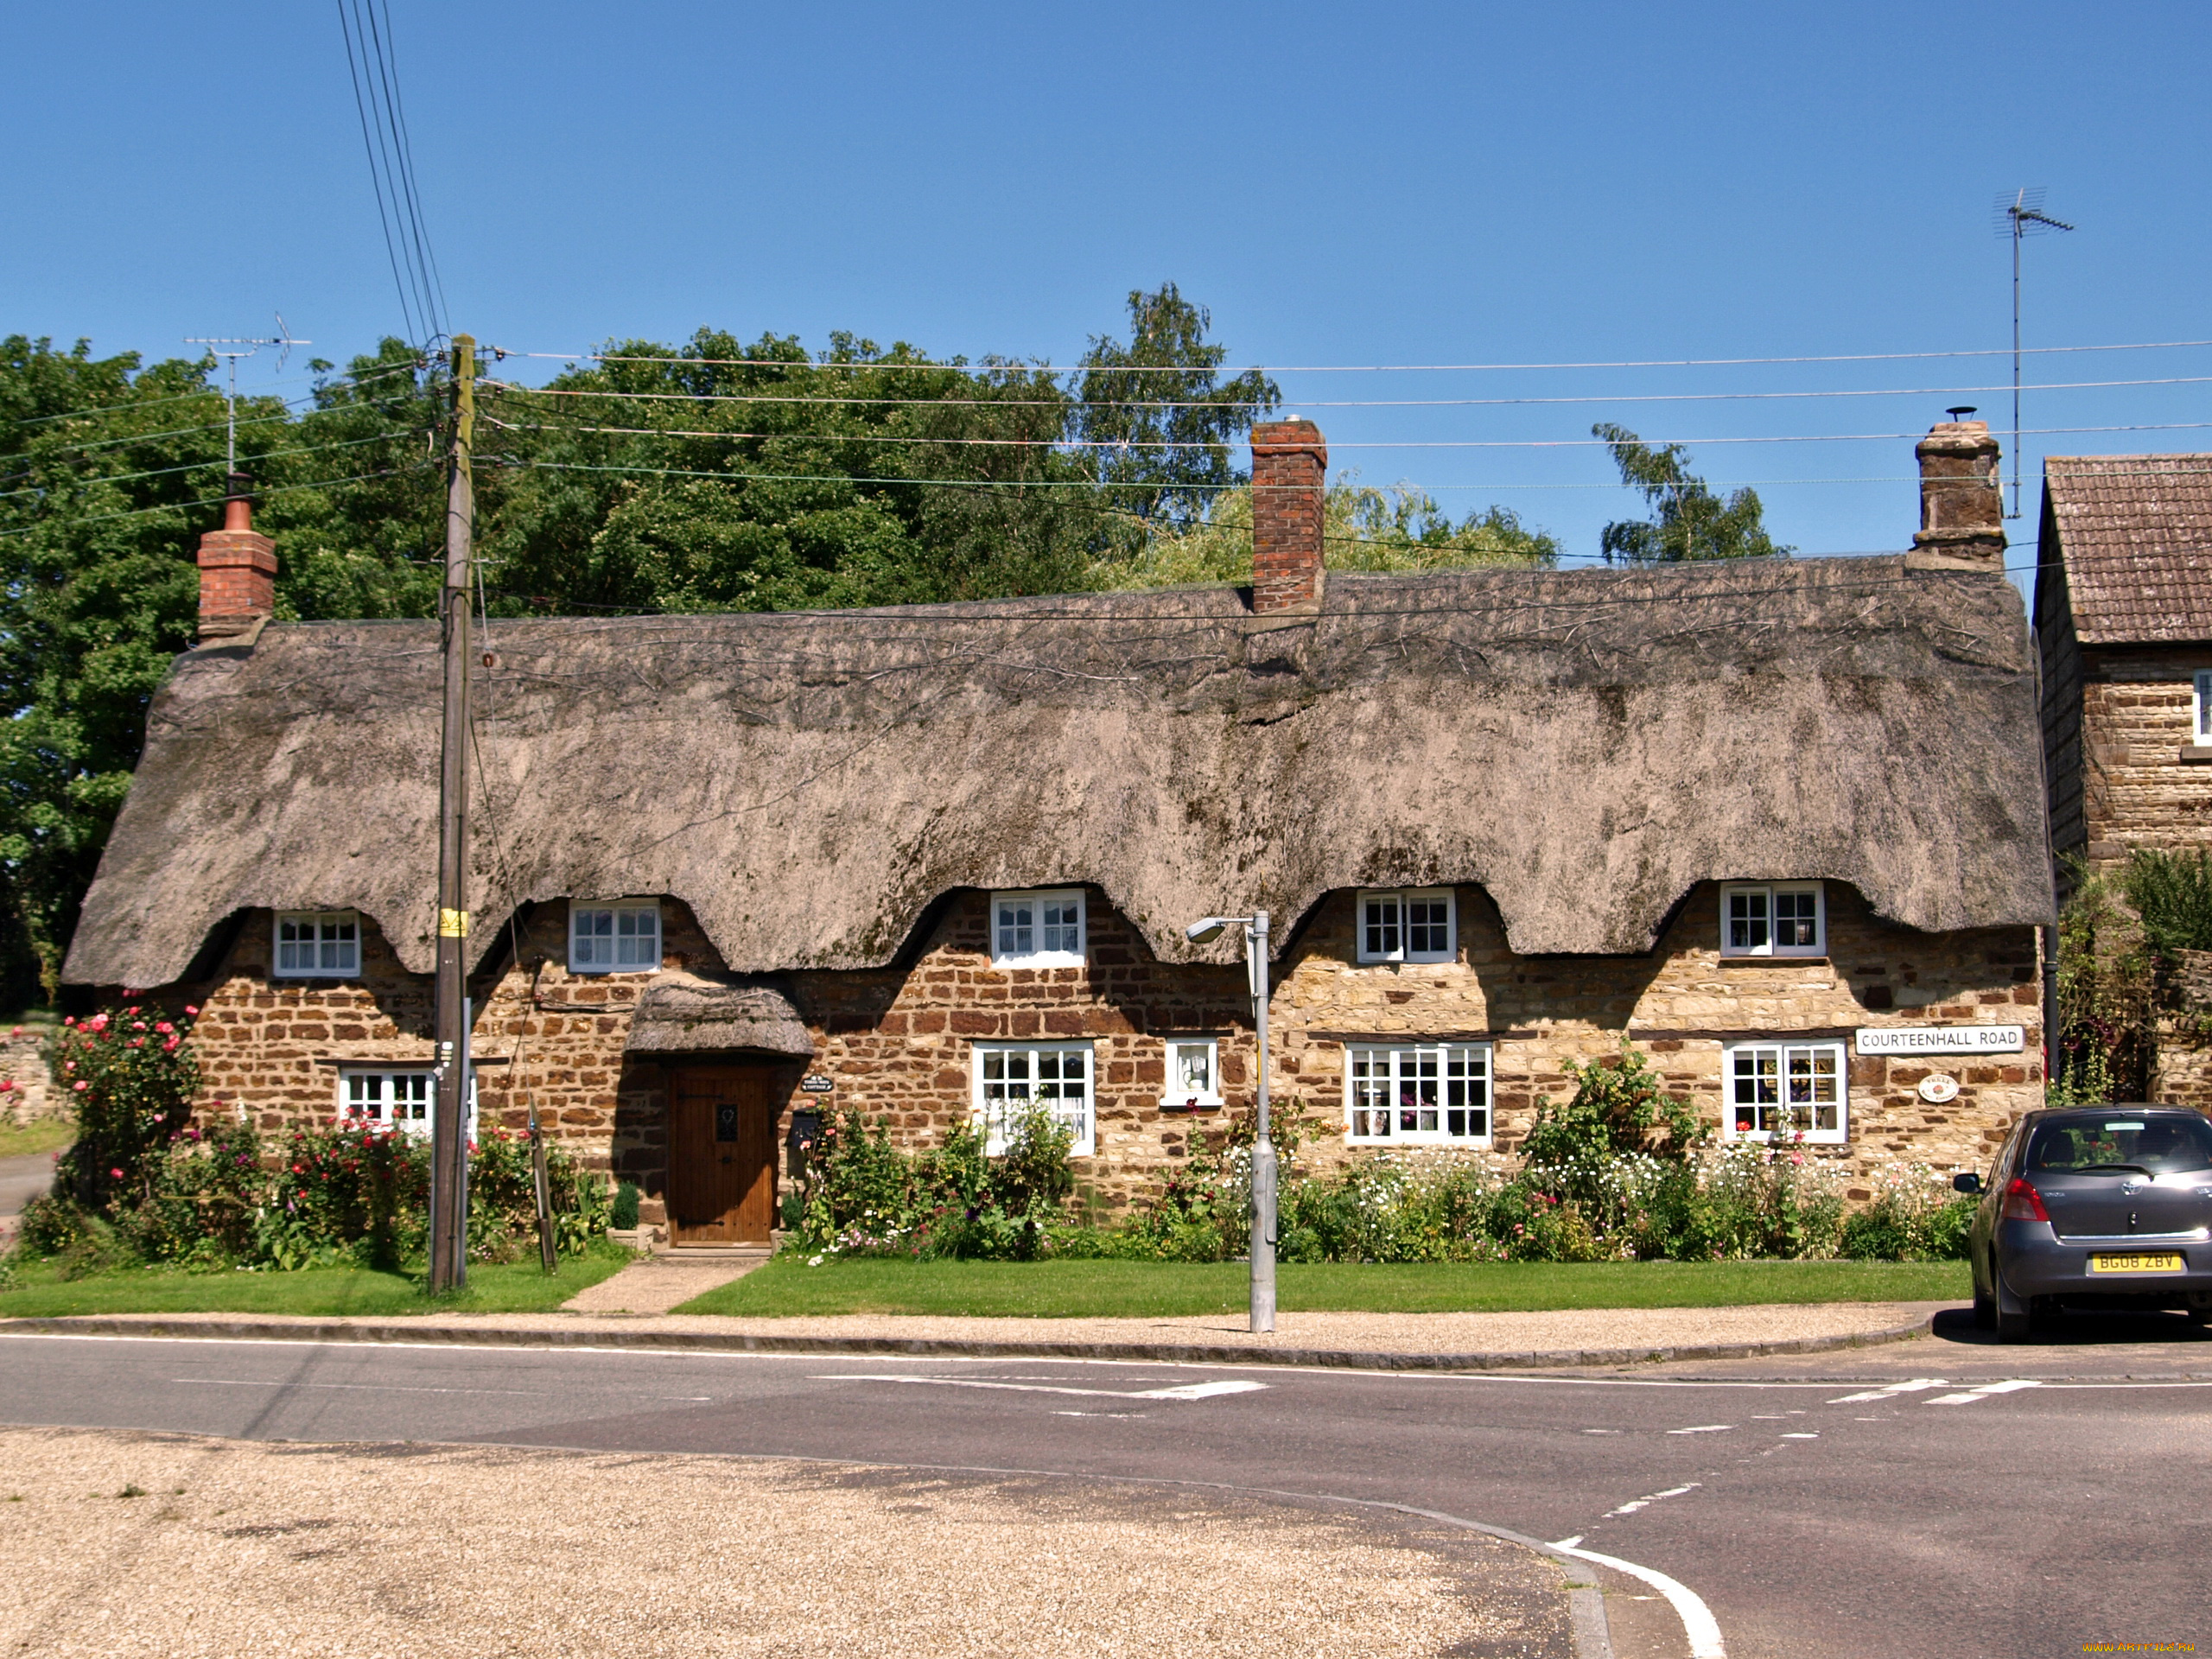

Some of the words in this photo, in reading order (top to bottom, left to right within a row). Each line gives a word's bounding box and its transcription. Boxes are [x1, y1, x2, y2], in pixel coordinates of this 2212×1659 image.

[1862, 1033, 1972, 1046] COURTEENHALL
[1980, 1031, 2018, 1046] ROAD
[2101, 1255, 2139, 1268] BG08
[2144, 1255, 2173, 1268] ZBV
